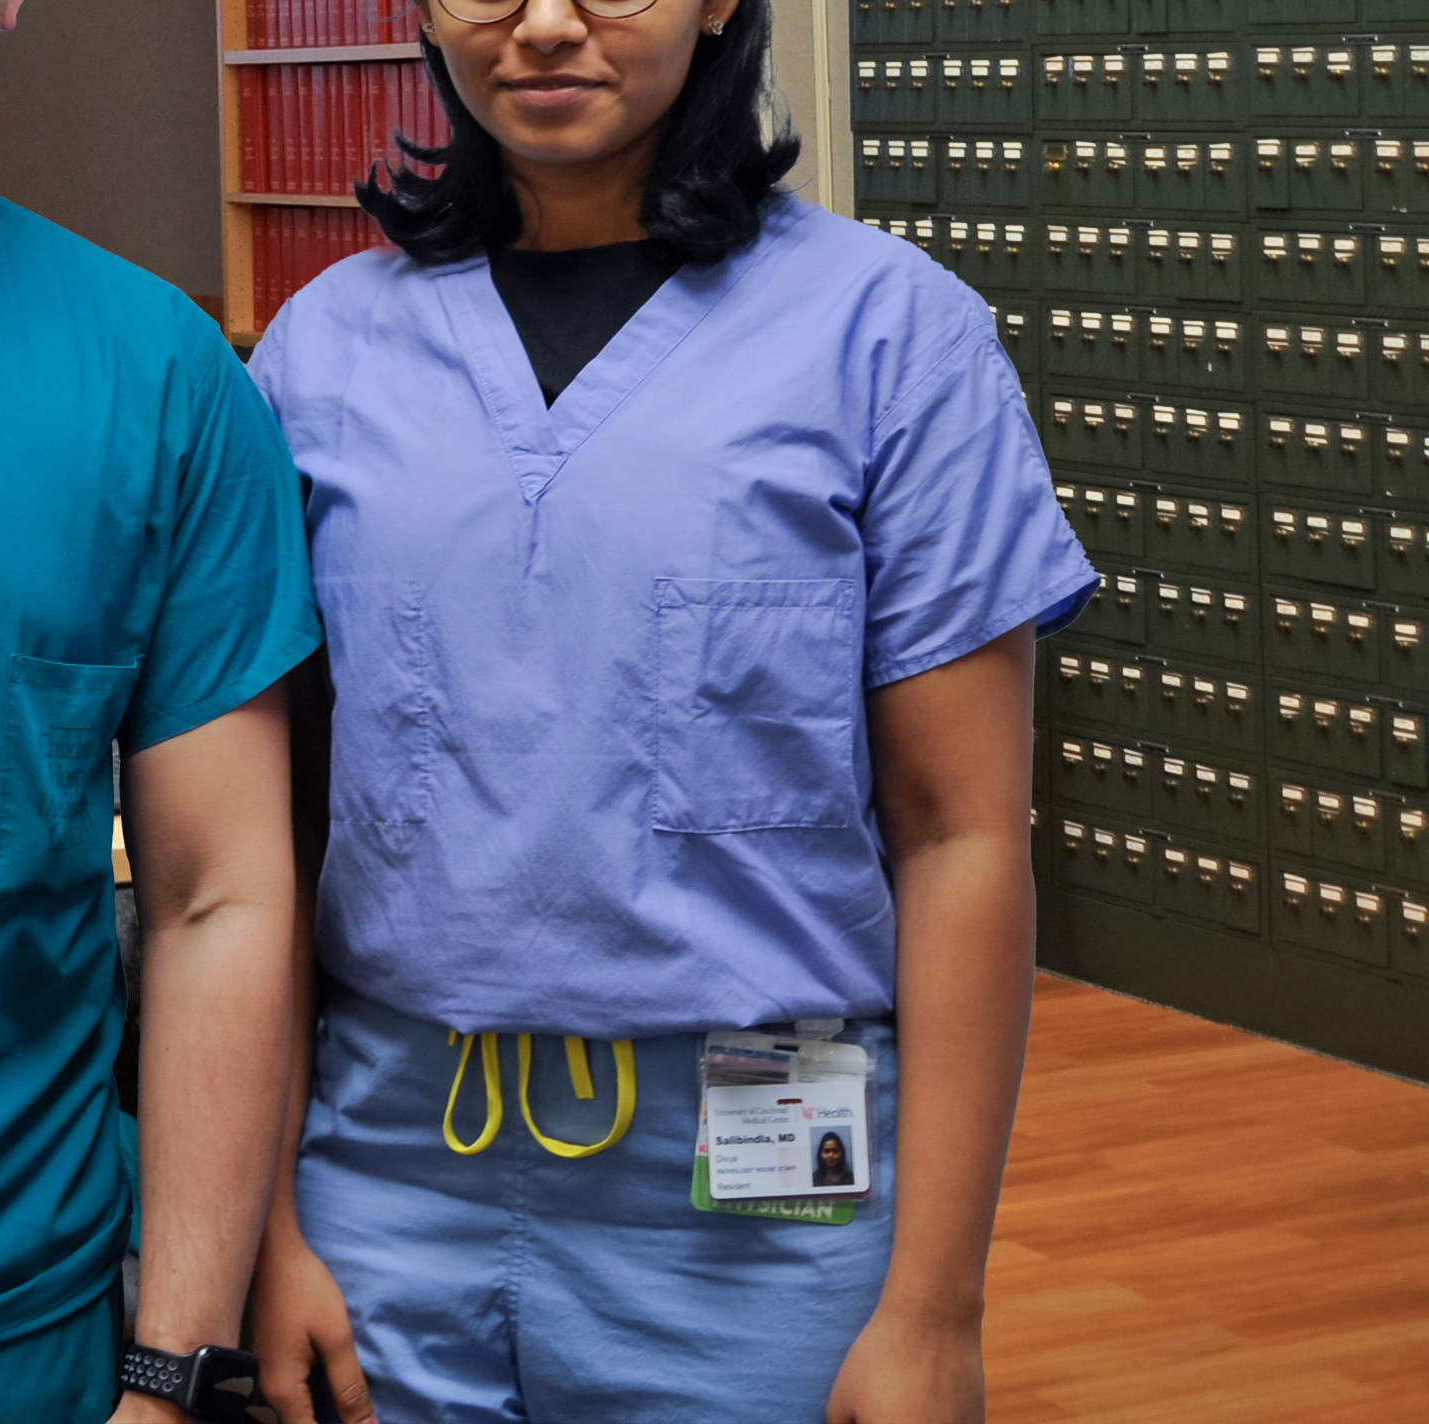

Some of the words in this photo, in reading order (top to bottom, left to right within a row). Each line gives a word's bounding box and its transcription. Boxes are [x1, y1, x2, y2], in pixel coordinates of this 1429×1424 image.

[817, 1106, 853, 1120] Health
[777, 1133, 796, 1143] MD
[717, 1182, 752, 1191] Resident
